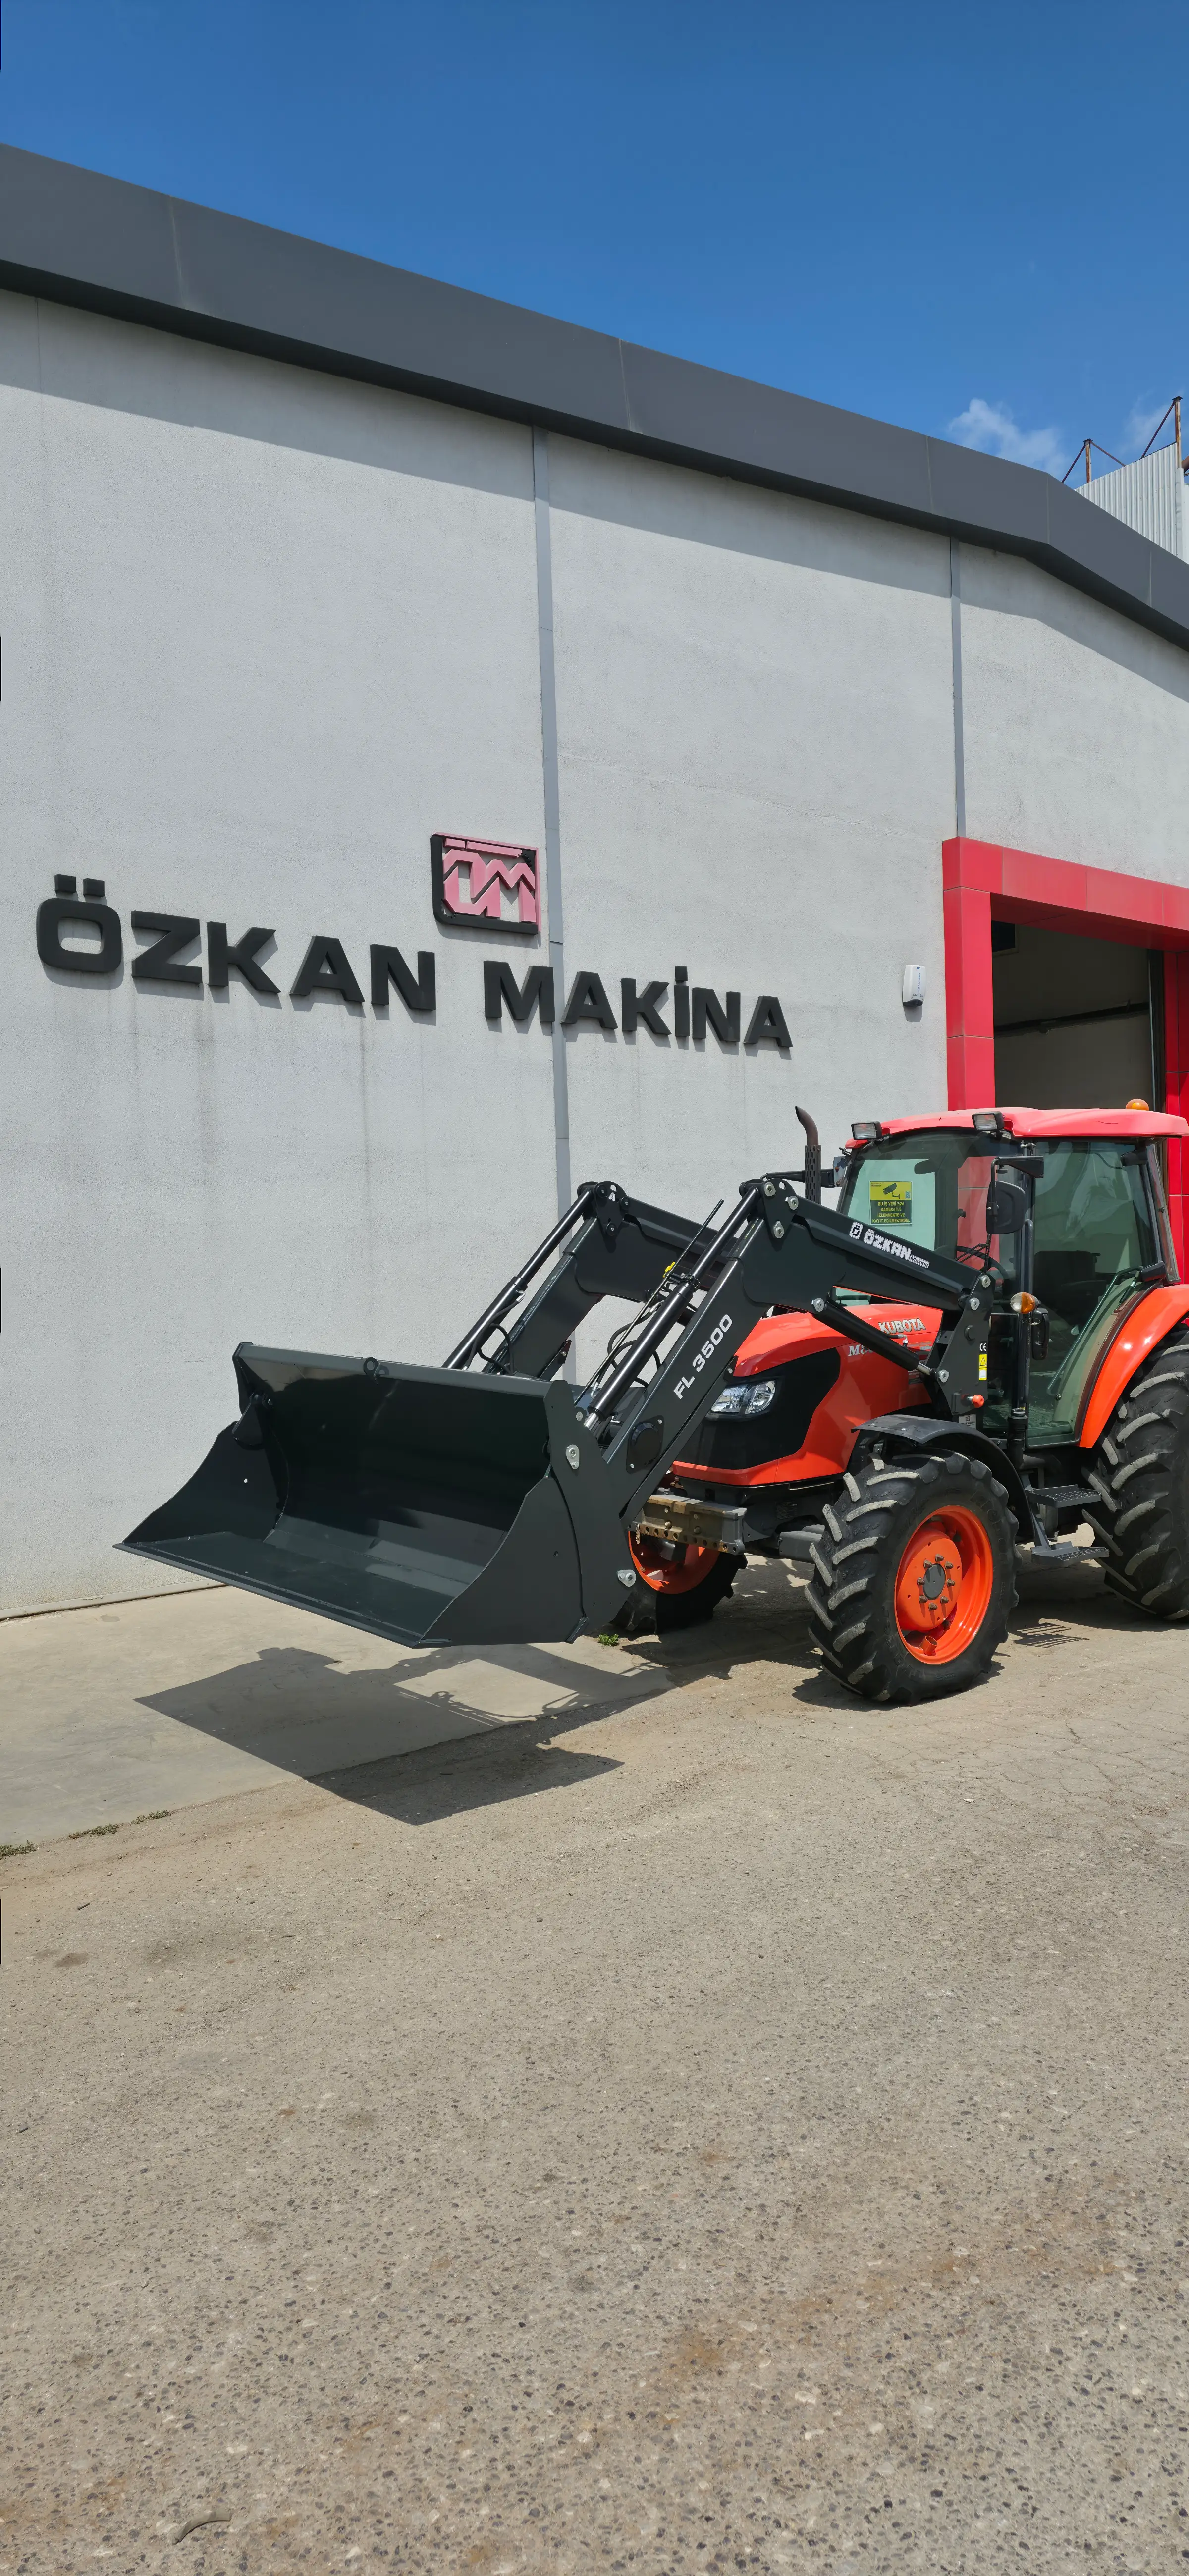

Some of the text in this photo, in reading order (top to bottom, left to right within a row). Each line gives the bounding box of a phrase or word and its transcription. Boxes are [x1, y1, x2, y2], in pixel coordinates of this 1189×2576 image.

[36, 874, 794, 1048] ÖZKAN MAKİNA
[864, 1229, 912, 1261] ÖZKAN
[910, 1255, 929, 1268] Makina
[878, 1318, 927, 1334] KUBOTA
[674, 1314, 732, 1400] FL 3500
[848, 1344, 873, 1356] M8
